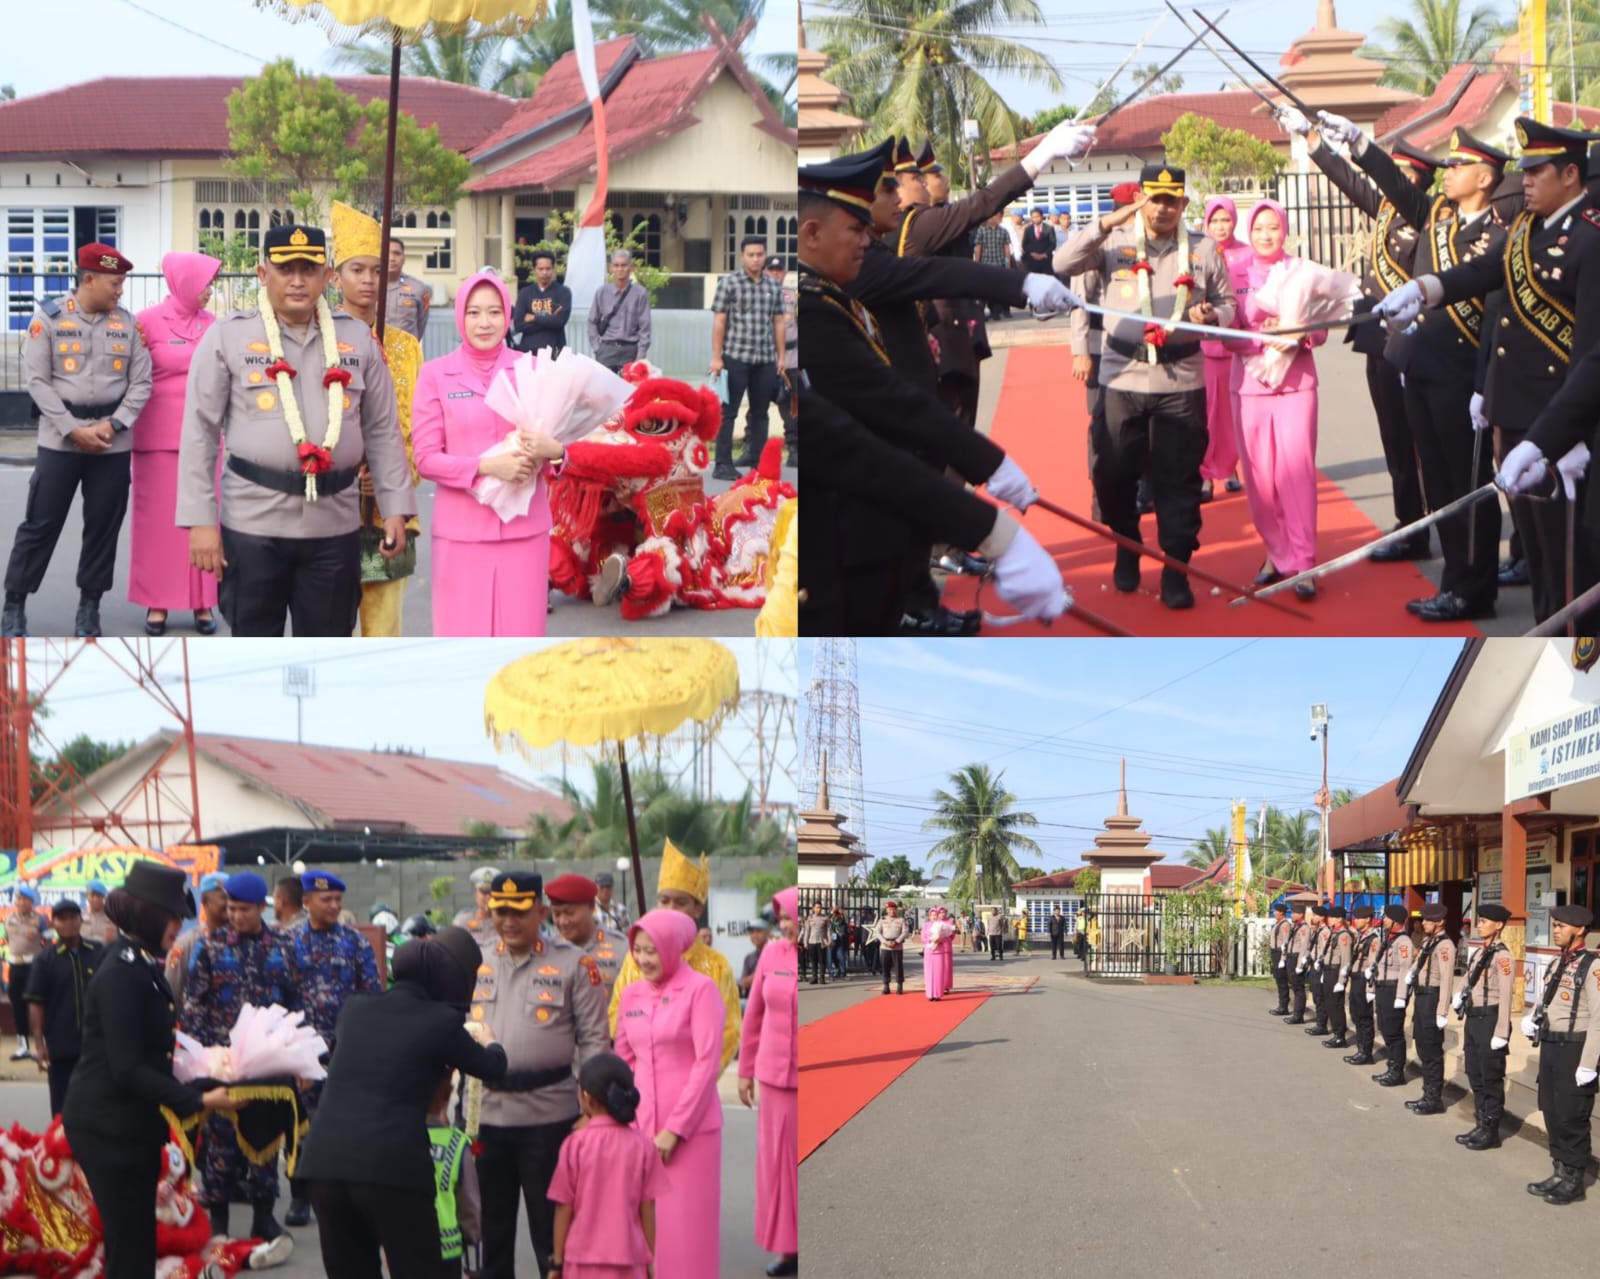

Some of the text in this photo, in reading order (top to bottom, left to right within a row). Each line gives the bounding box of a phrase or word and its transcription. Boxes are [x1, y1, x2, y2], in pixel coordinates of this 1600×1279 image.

[1517, 279, 1561, 332] TANJAB
[105, 331, 129, 339] POLRI
[245, 356, 274, 366] WICA
[1530, 727, 1551, 750] KAMI
[1552, 718, 1573, 742] SIAP
[532, 976, 562, 987] POLRI
